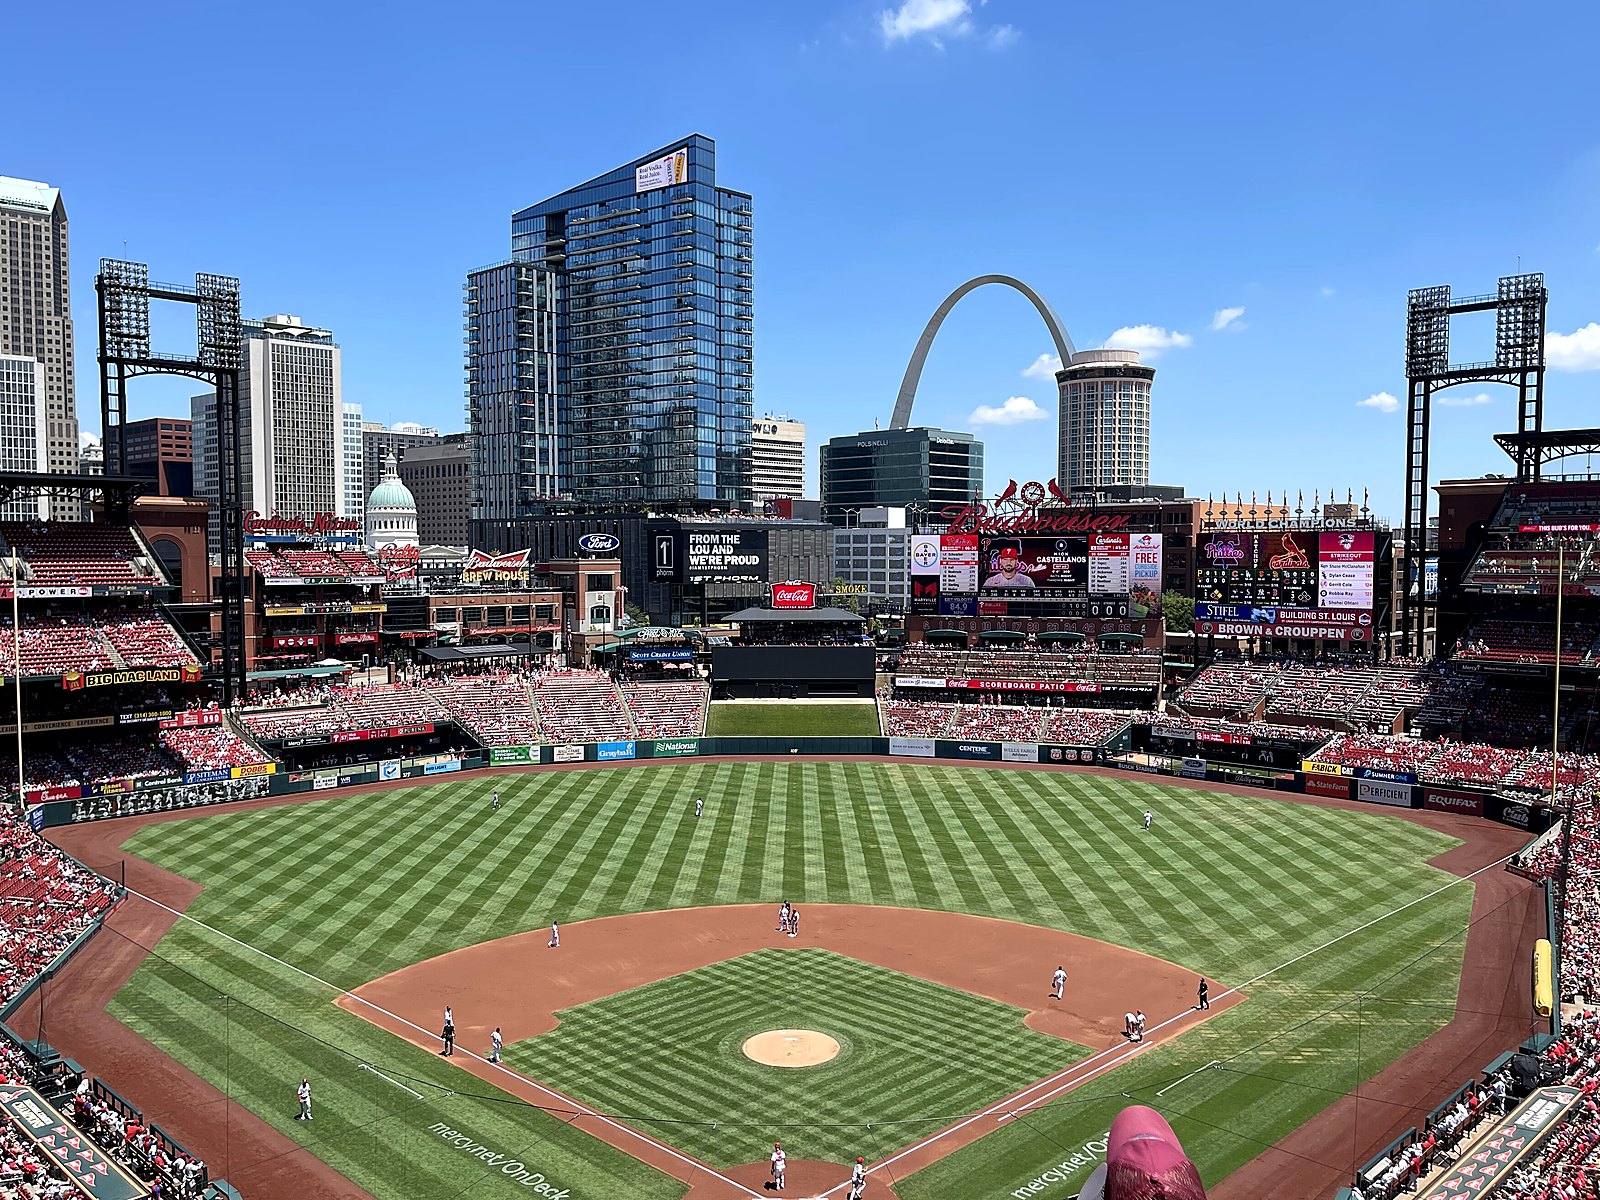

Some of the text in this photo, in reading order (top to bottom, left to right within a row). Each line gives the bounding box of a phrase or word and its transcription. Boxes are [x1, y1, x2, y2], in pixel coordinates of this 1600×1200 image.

[857, 440, 888, 449] POLSINELLI
[243, 511, 360, 535] Cardinals Nation
[940, 504, 1132, 535] Budweiser
[1215, 518, 1358, 529] WORLD CHAMPIONS
[587, 535, 612, 549] Ford
[689, 534, 740, 544] FROM THE
[689, 545, 734, 555] LOU AND
[689, 555, 760, 565] WE'RE PROUD
[1135, 552, 1158, 564] FREE
[463, 570, 530, 582] BREW HOUSE
[656, 569, 673, 578] phorm
[1134, 570, 1158, 578] PICKUP
[28, 588, 77, 596] POWER
[835, 584, 868, 594] SMOKE
[949, 603, 968, 611] 84.9
[1092, 606, 1126, 615] 0 0 0
[1206, 604, 1240, 617] STIFEL
[1279, 611, 1356, 621] BUILDING ST. LOUIS
[1218, 624, 1346, 638] BROWN & CROUPPEN
[631, 650, 691, 659] SCOTT CREDIT UNION
[86, 669, 181, 687] BIG MAC LAND
[979, 681, 1036, 689] SCOREBOARD
[33, 718, 109, 730] CONVENIENCE EXPERIENCE
[665, 742, 698, 751] National
[239, 765, 268, 775] DOBBS
[1135, 764, 1158, 773] STADIUM
[1311, 763, 1354, 775] FABICK CAT
[197, 769, 228, 779] SITEMAN
[100, 782, 122, 791] planet
[144, 776, 183, 788] Central Bank
[1359, 784, 1408, 800] PERFICIENT
[1427, 794, 1478, 808] EQUIFAX
[1502, 806, 1529, 823] Club
[427, 1121, 571, 1200] mercy.net/OnDeck
